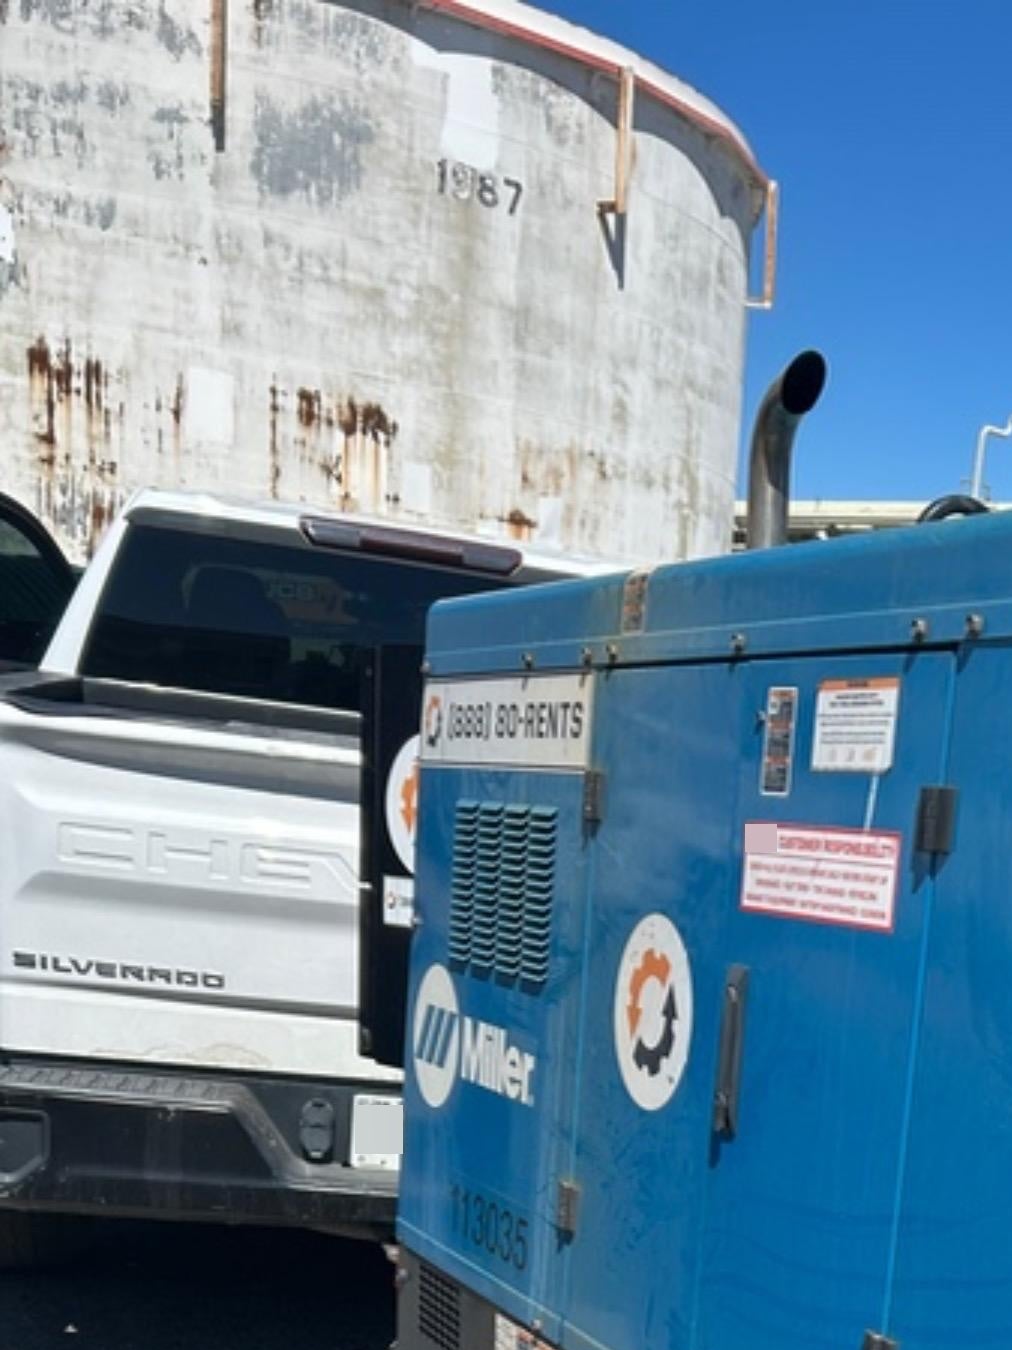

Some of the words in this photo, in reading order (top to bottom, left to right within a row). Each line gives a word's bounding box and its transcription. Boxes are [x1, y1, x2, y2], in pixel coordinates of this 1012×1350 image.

[437, 158, 523, 215] 1987
[12, 950, 226, 990] SILVERADO
[460, 1015, 536, 1106] Miller
